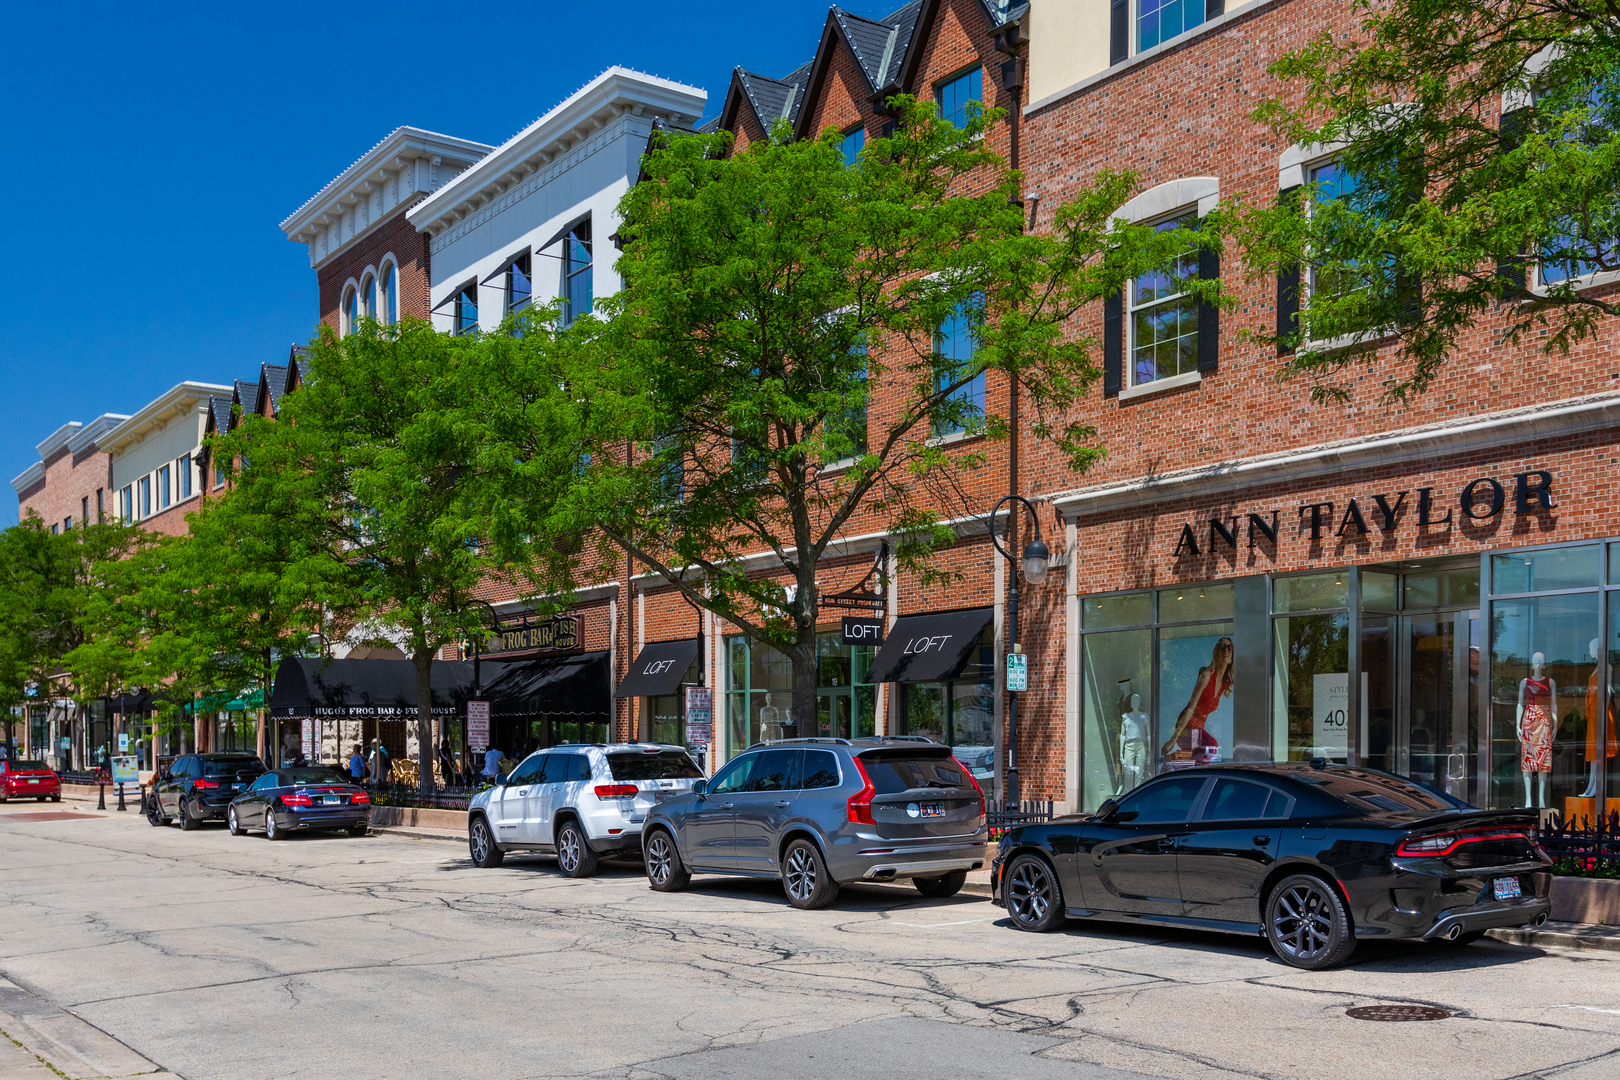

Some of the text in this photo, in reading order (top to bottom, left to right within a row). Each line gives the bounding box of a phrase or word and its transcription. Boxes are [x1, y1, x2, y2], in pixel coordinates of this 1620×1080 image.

[1172, 471, 1558, 556] ANN TAYLOR
[554, 620, 576, 637] FISH
[845, 623, 881, 638] LOFT
[502, 630, 528, 650] FROG
[530, 627, 549, 647] BAR
[555, 637, 574, 647] HOUSE
[903, 634, 953, 654] LOFT
[643, 660, 676, 675] LOFT
[1009, 657, 1014, 667] 2
[315, 706, 346, 714] HUGO'S
